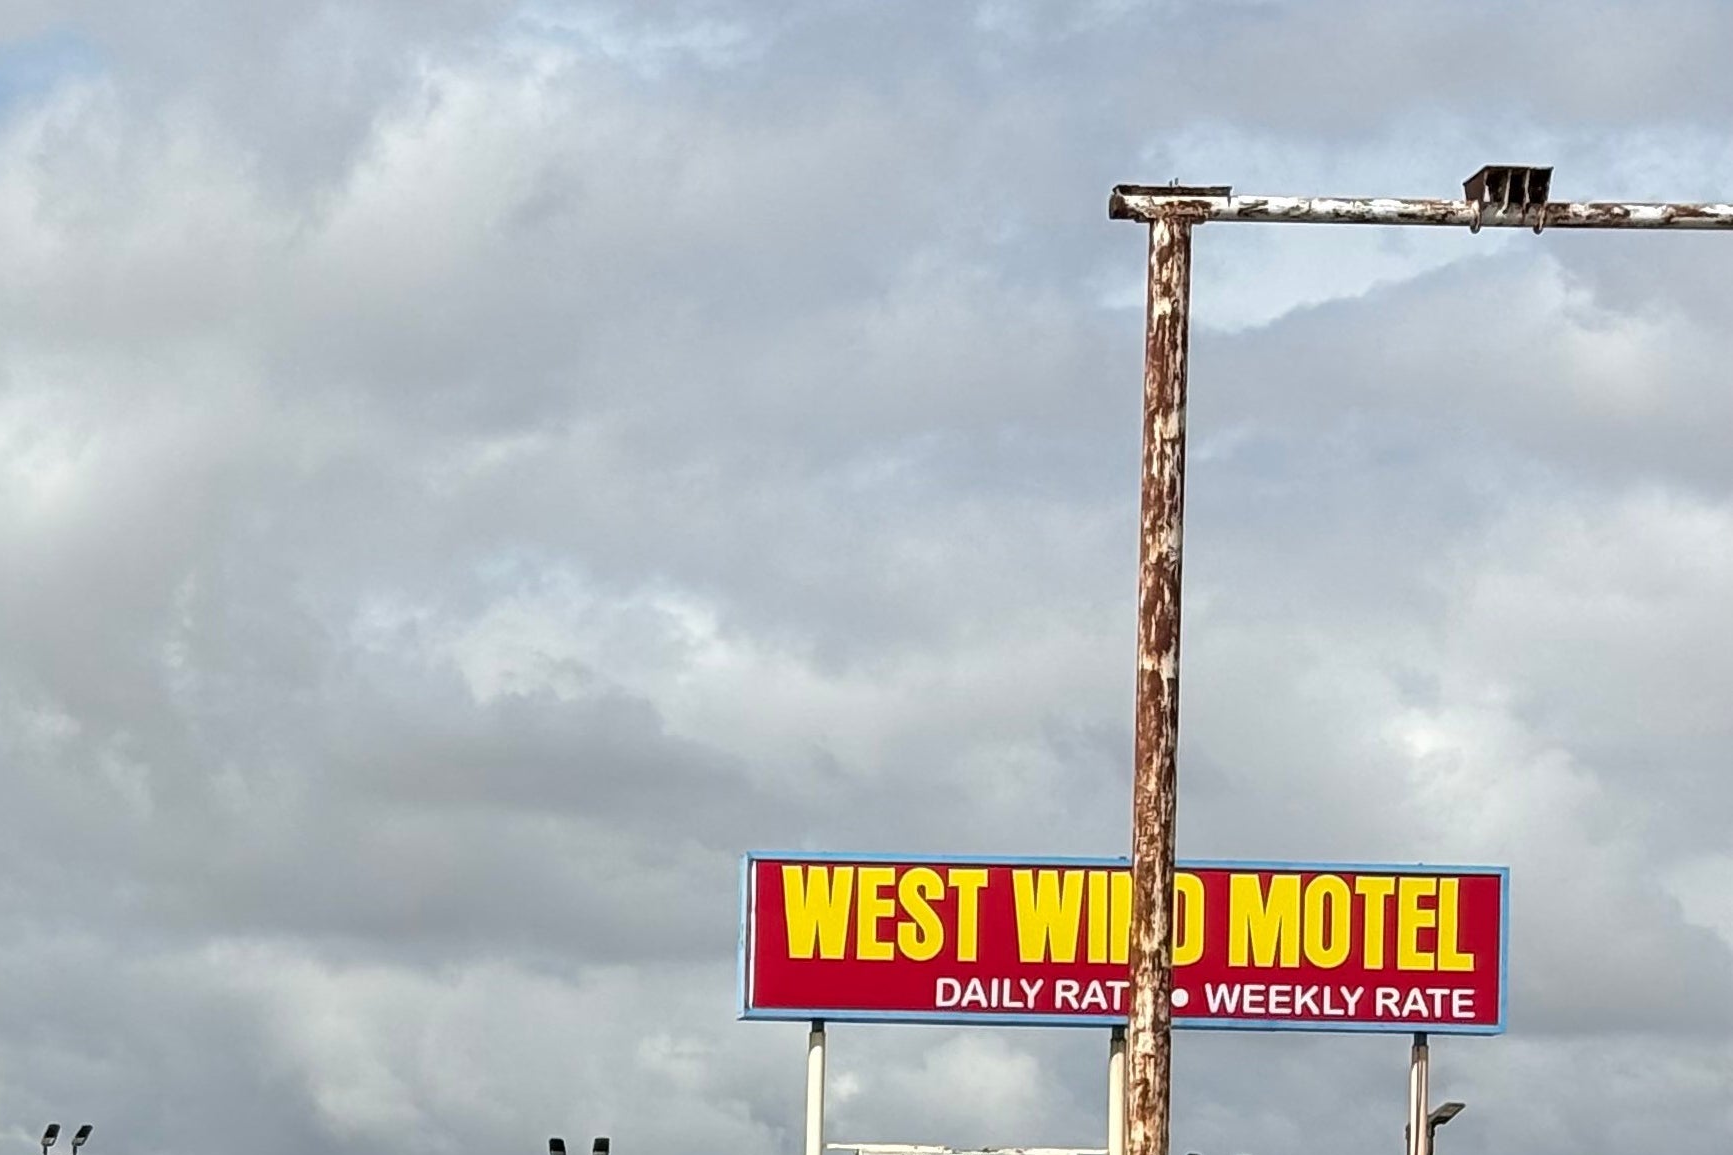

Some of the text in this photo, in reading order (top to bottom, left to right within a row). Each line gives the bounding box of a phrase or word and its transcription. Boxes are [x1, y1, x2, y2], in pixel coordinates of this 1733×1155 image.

[782, 865, 989, 962] WEST
[1228, 873, 1475, 971] MOTEL
[935, 977, 1476, 1018] DAILY RAT WEEKLY RATE
